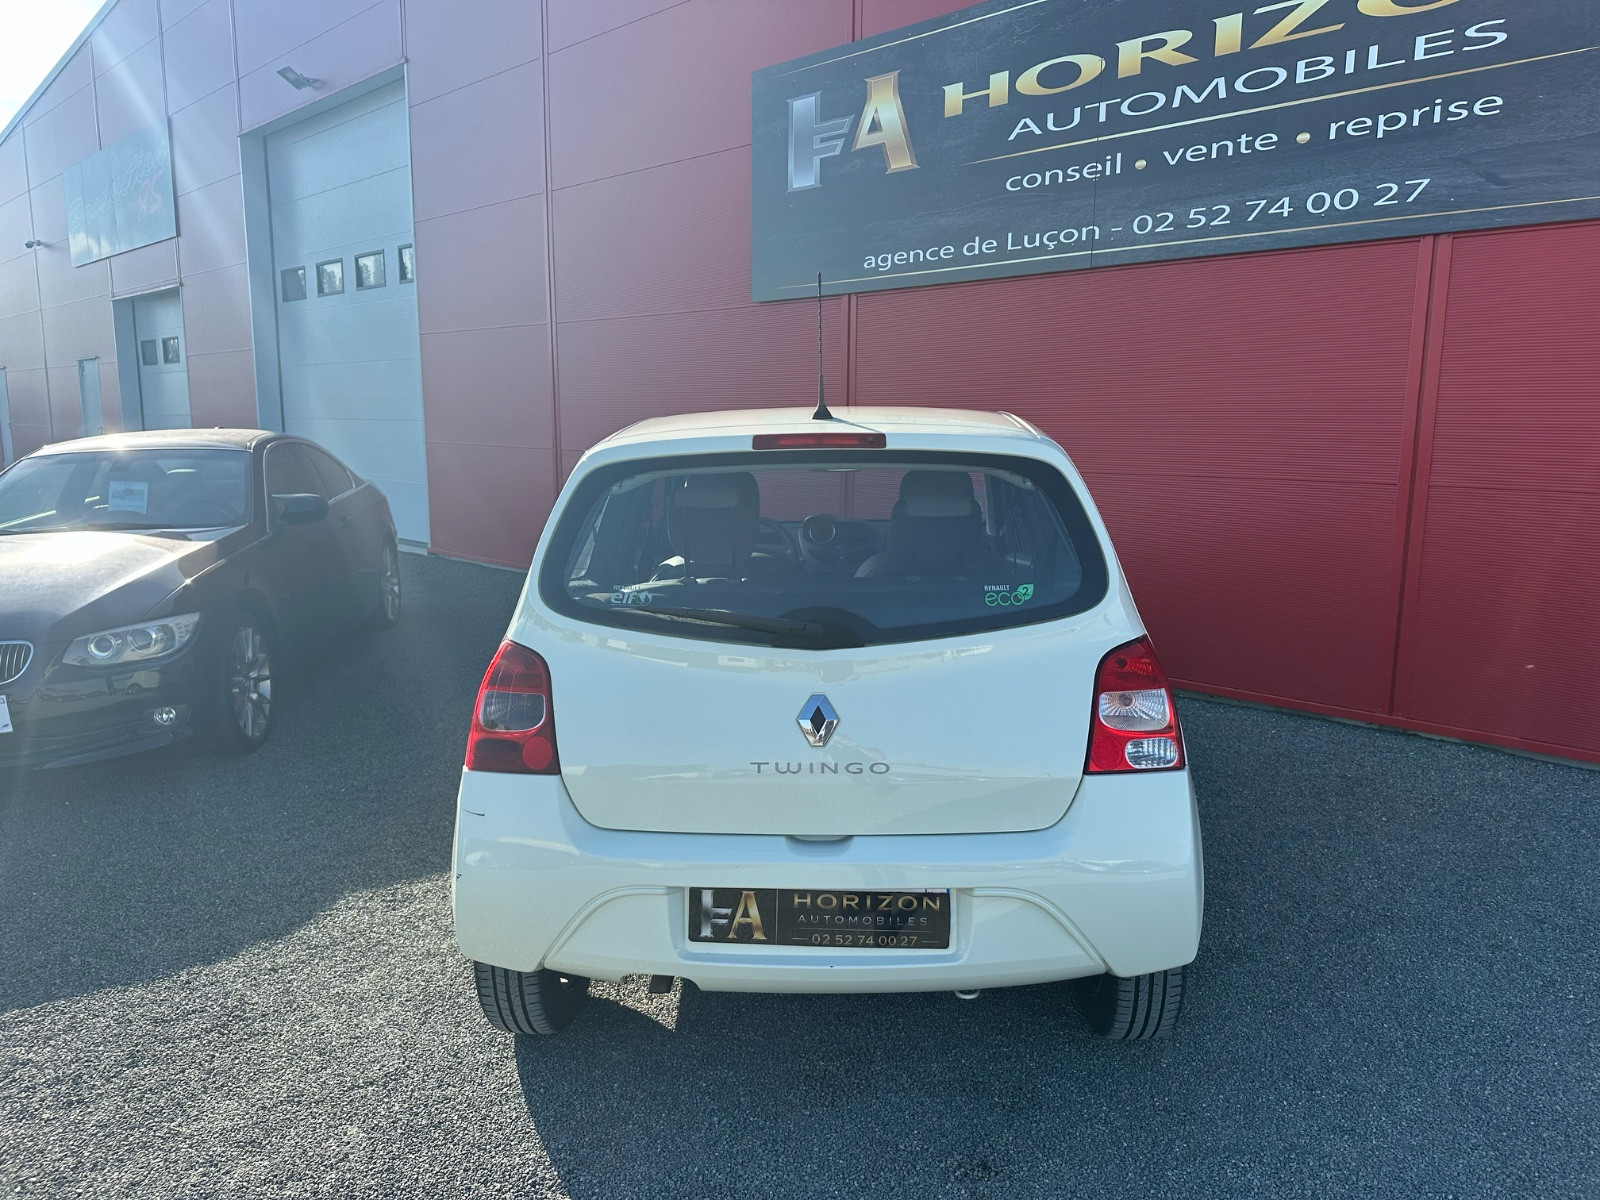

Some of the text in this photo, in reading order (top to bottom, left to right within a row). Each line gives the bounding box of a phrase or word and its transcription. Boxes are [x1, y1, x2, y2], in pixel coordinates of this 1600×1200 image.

[1008, 19, 1508, 141] AUTOMOBILES
[1005, 95, 1504, 191] conseil vente reprise
[863, 245, 955, 271] agence
[962, 236, 998, 256] de
[1007, 224, 1100, 250] Luçon
[1132, 212, 1175, 235] 02
[1186, 204, 1231, 229] 52
[1245, 196, 1294, 222] 74
[1306, 187, 1359, 214] 00
[1373, 178, 1431, 206] 27
[984, 584, 1010, 592] RENAULT
[610, 591, 638, 604] elf
[750, 762, 891, 775] TWINGO
[793, 893, 941, 912] HORIZON
[798, 914, 928, 927] AUTOMOBILES
[811, 933, 918, 947] 02 52 74 00 27
